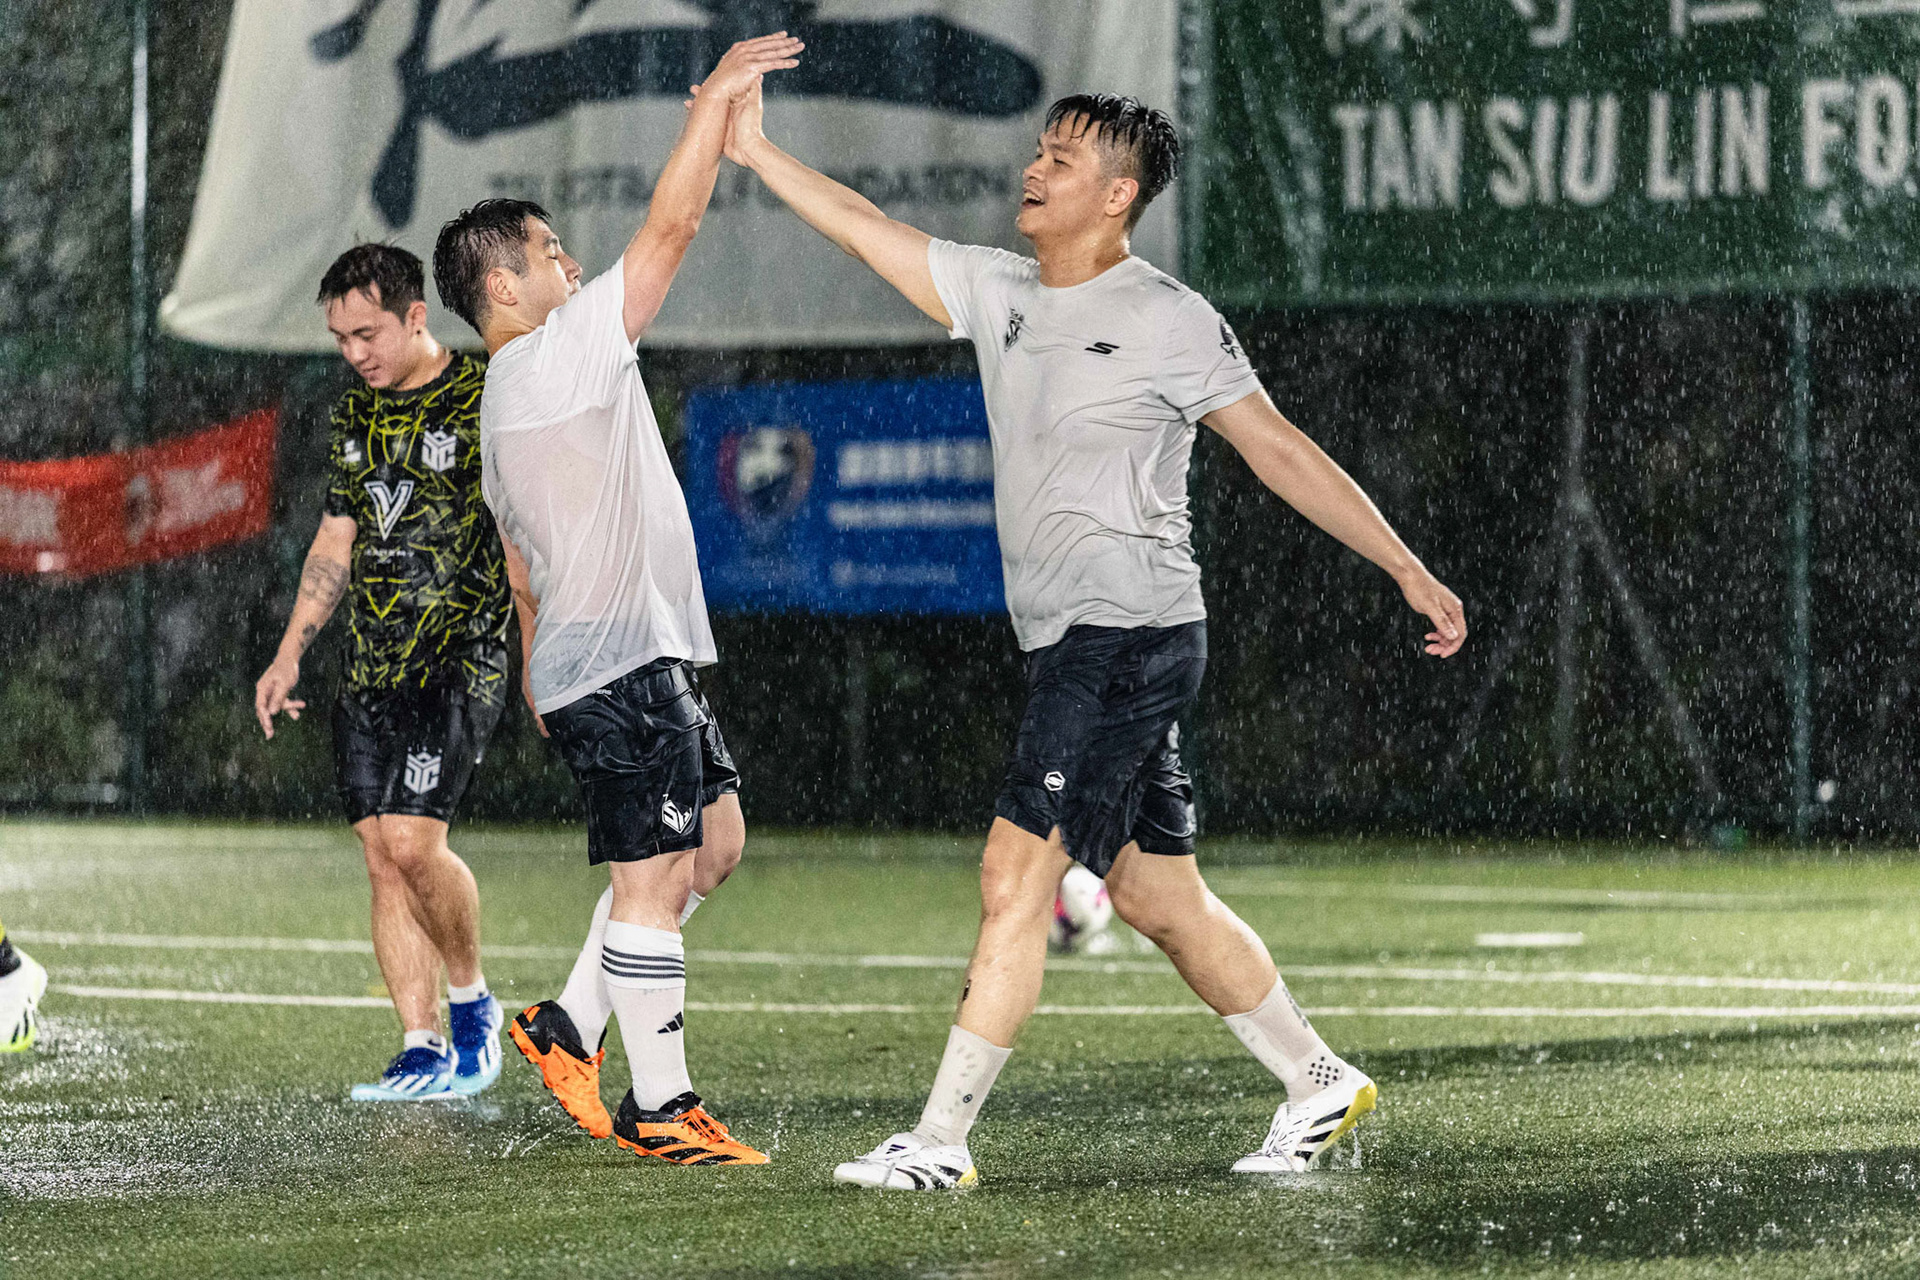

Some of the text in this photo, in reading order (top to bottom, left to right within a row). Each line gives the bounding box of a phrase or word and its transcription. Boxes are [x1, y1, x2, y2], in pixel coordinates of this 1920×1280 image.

[1333, 74, 1920, 210] TAN SIU LIN FO
